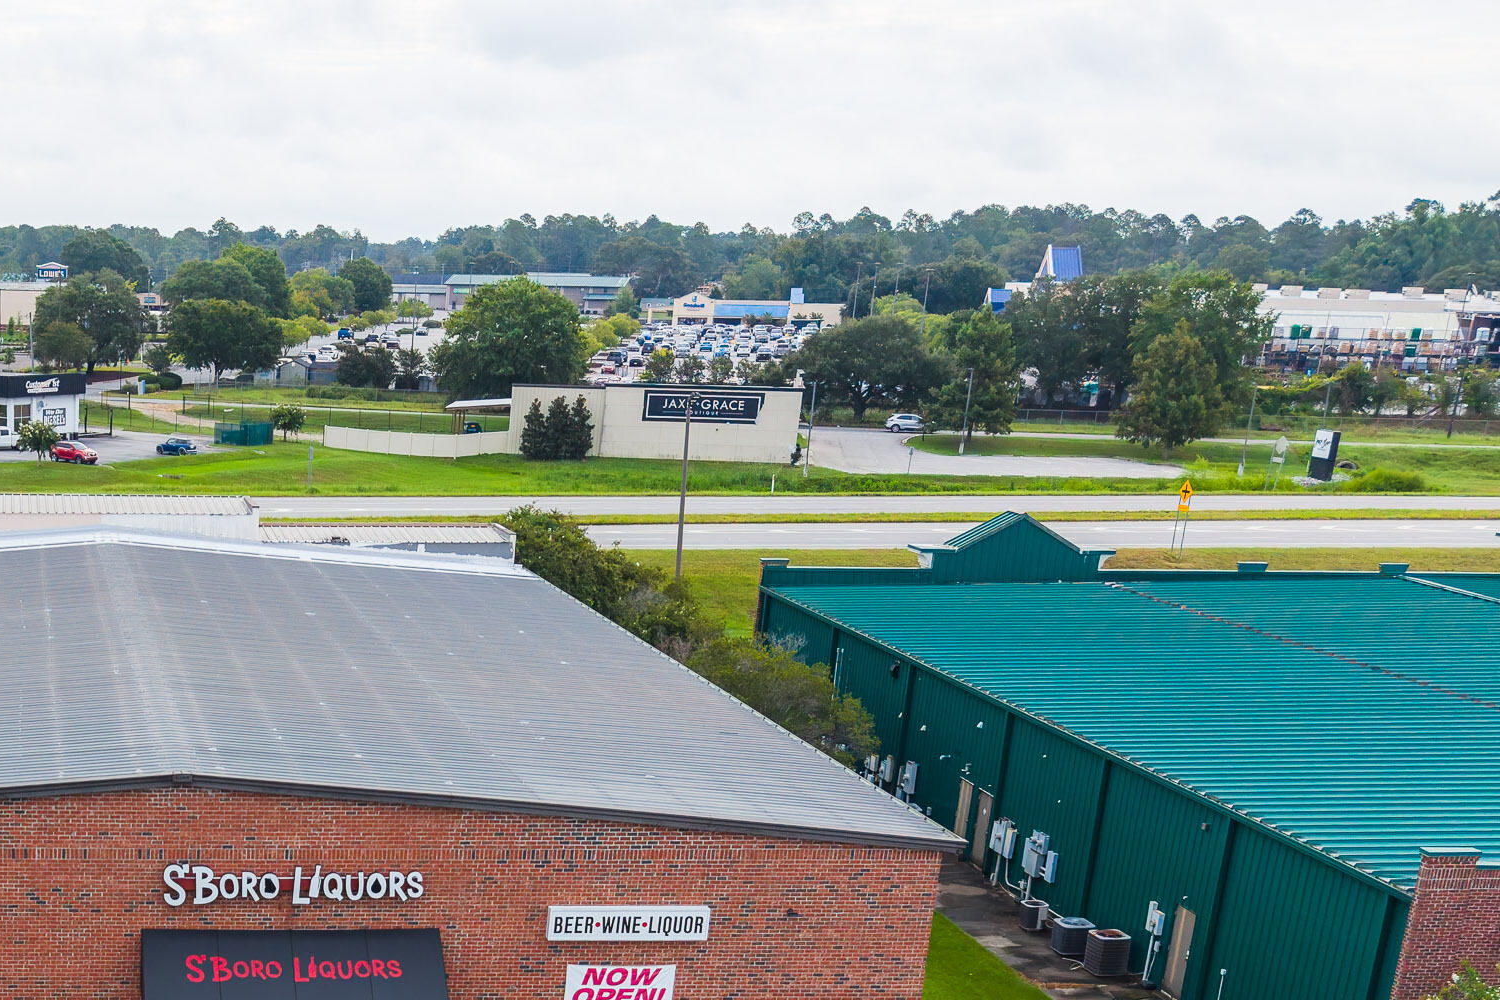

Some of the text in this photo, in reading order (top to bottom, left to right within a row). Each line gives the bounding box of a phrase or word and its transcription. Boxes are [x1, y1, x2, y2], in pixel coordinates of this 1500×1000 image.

[38, 268, 65, 278] LOWE'S
[662, 398, 745, 411] JAX GRACE
[292, 864, 425, 905] LIQUORS
[553, 915, 705, 937] BEER WINE LIQUOR
[293, 955, 403, 983] LIQUORS
[581, 967, 664, 986] NOW
